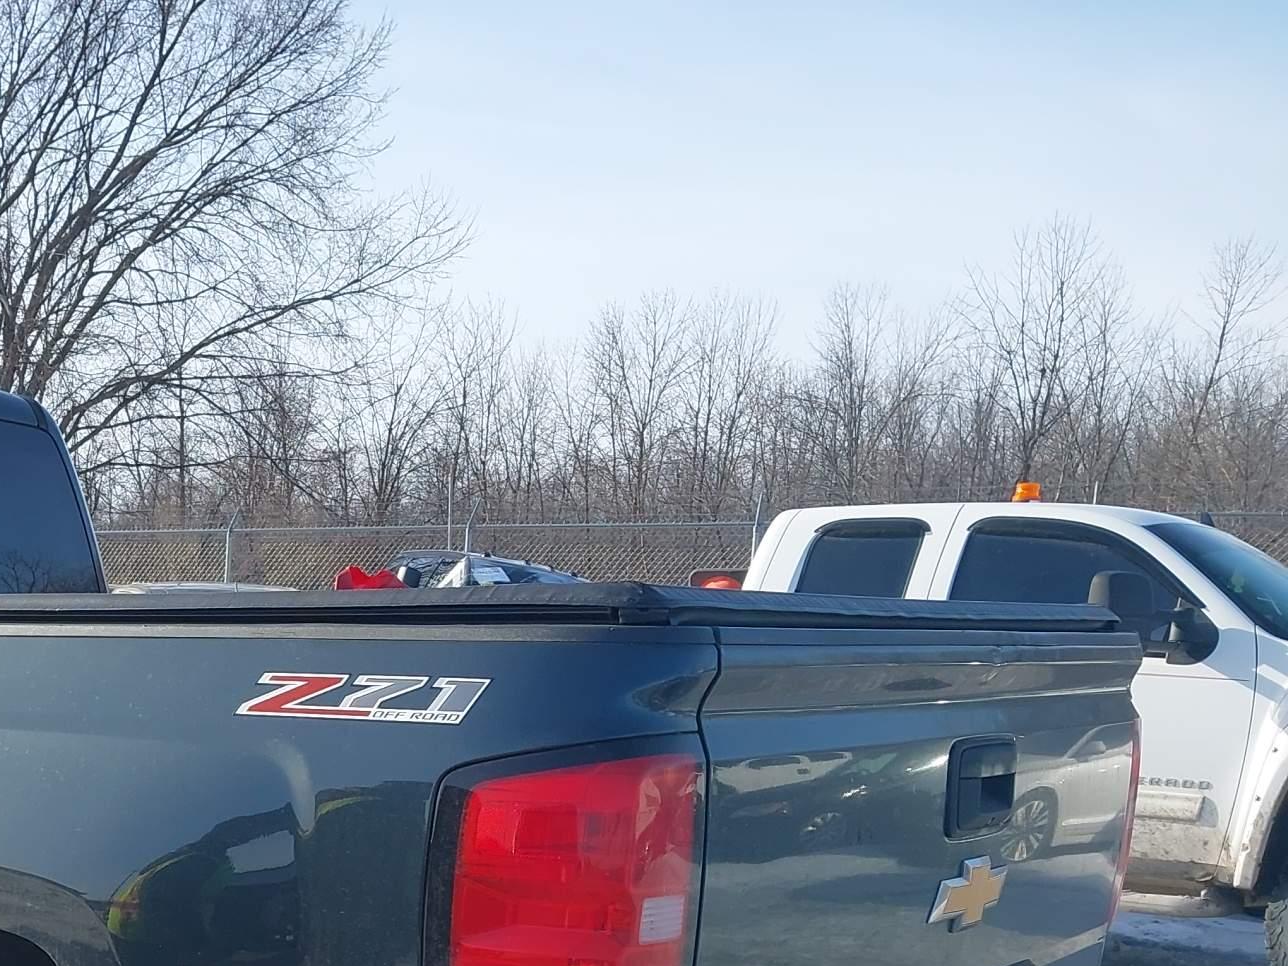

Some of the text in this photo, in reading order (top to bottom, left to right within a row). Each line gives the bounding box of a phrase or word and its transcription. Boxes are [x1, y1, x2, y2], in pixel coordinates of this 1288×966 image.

[233, 671, 492, 718] Z71
[372, 710, 460, 722] OFF ROAD
